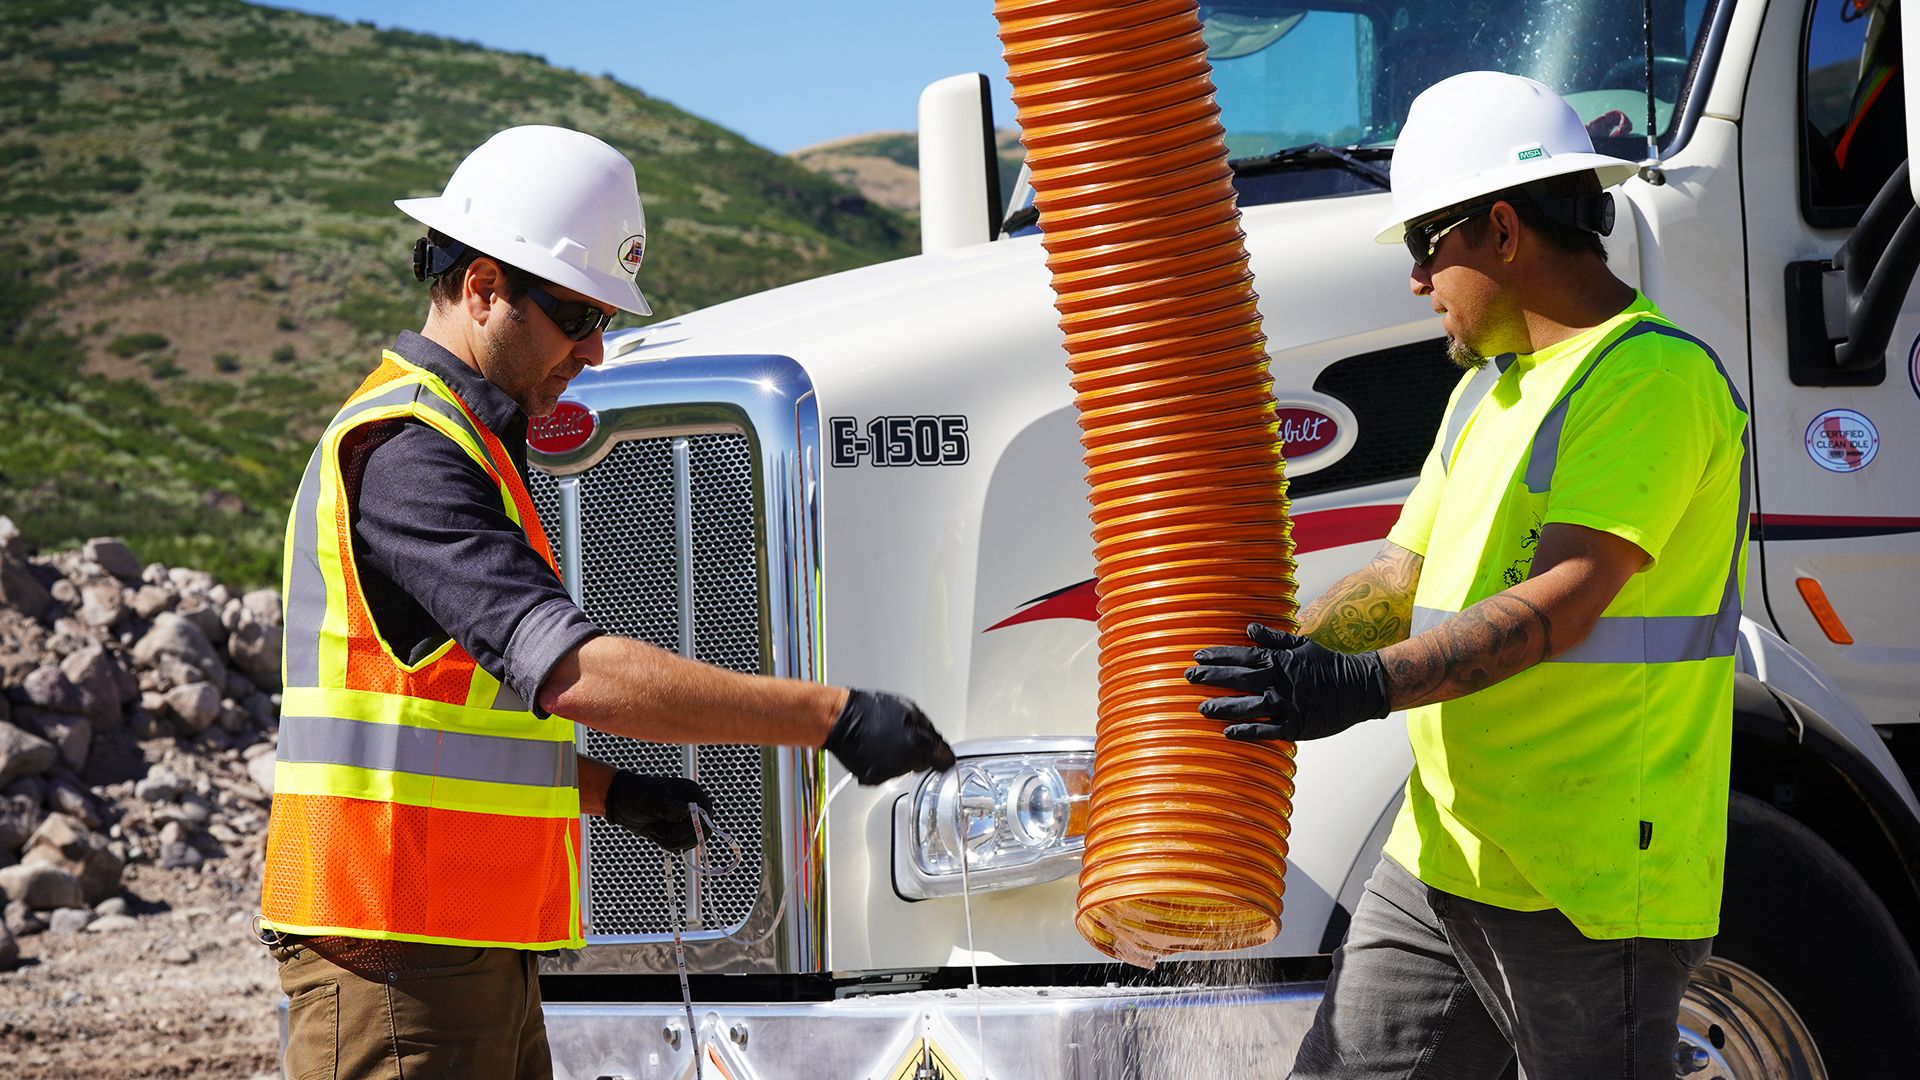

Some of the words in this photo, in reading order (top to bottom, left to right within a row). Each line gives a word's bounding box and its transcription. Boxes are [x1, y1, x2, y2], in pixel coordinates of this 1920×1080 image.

[1519, 149, 1541, 160] MSA
[1820, 430, 1865, 438] CERTIFIED
[829, 415, 970, 468] E-1505
[1816, 441, 1847, 449] CLEAN
[1850, 440, 1869, 448] IDLE
